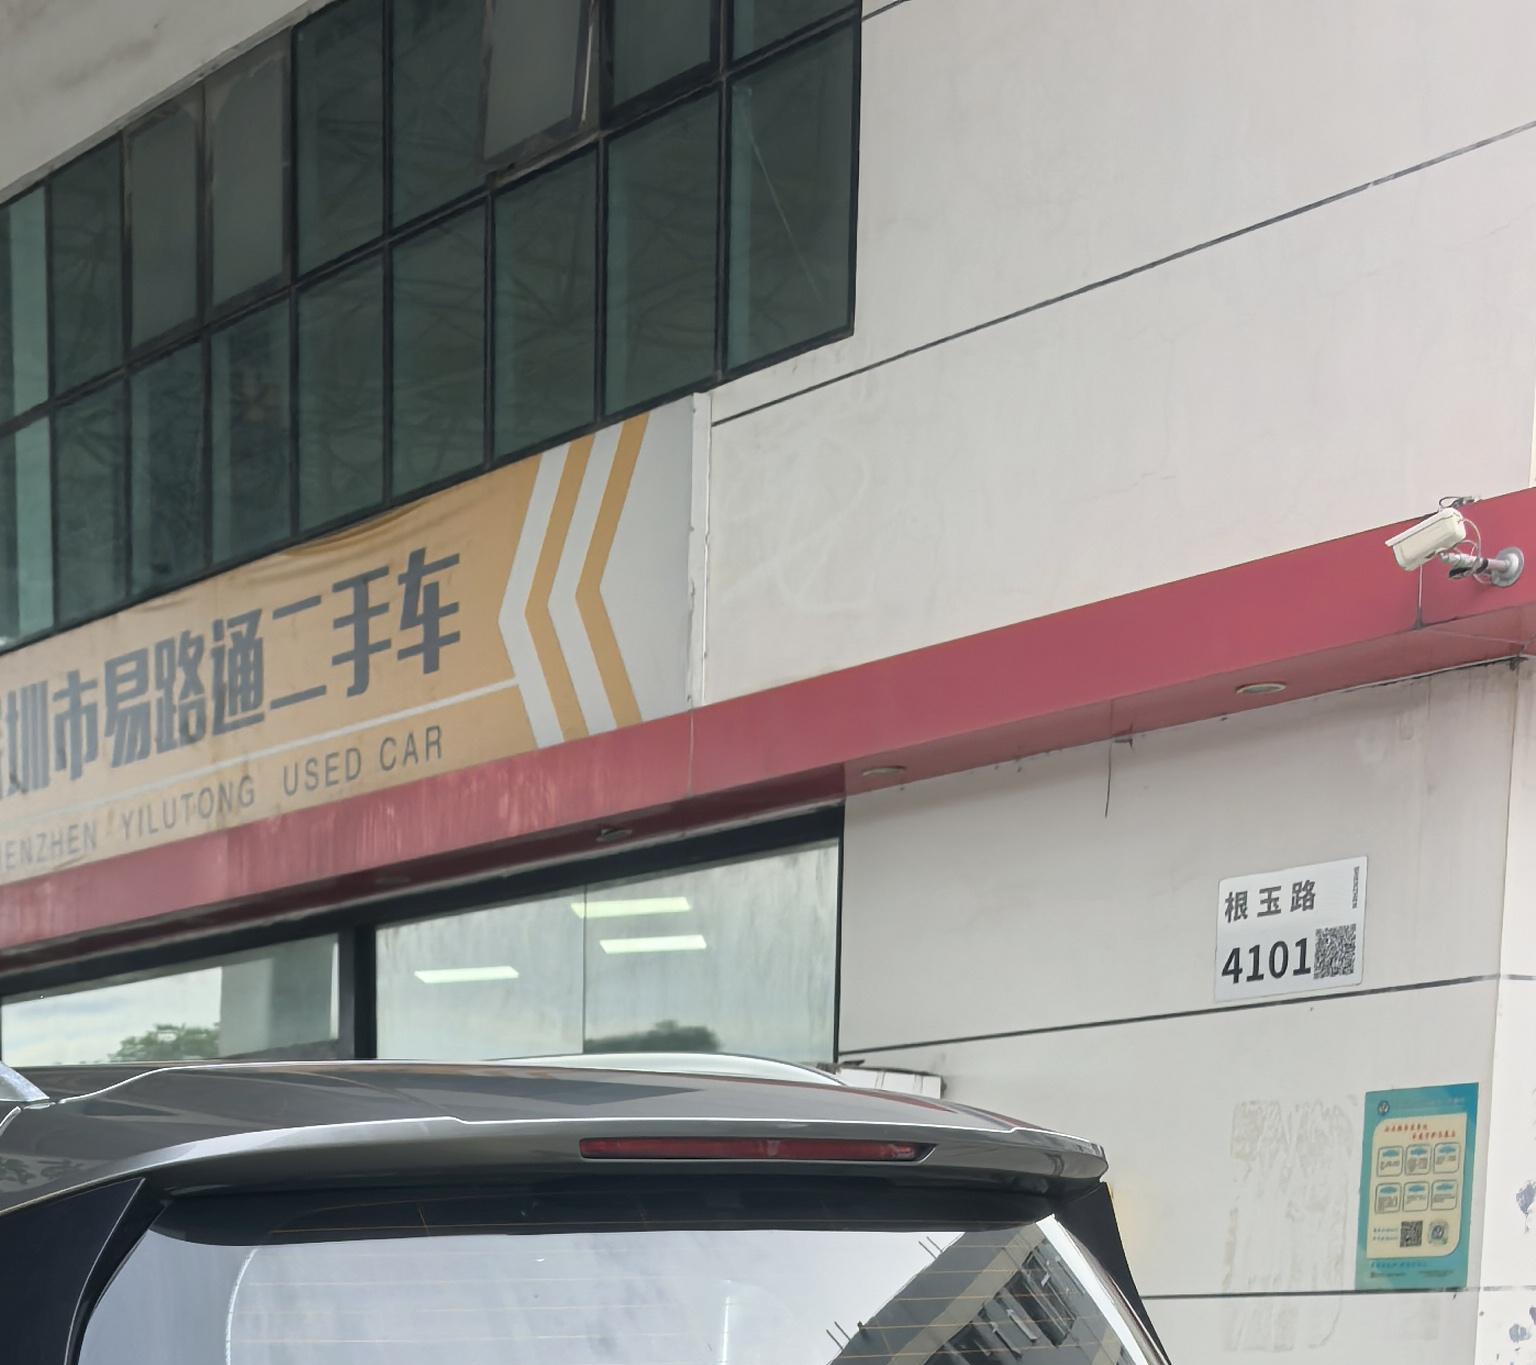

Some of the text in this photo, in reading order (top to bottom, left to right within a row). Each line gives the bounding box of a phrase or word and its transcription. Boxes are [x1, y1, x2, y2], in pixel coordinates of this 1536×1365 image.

[121, 775, 256, 837] YILUTONG
[283, 748, 361, 796] USED
[379, 724, 443, 774] CAR
[1225, 879, 1316, 923] 根玉路
[1221, 937, 1312, 984] 4101
